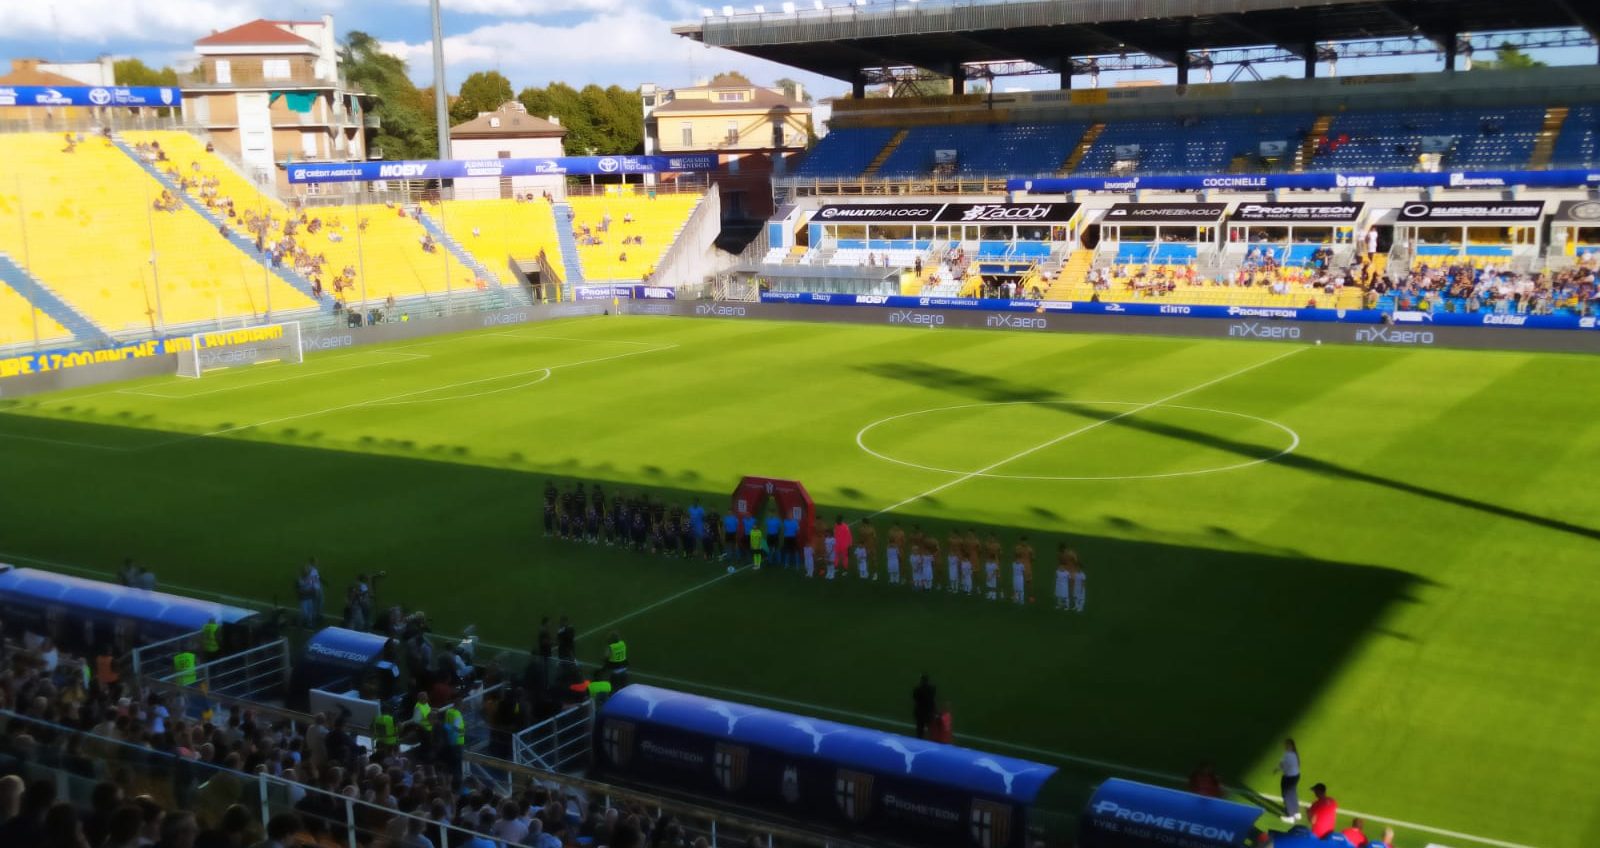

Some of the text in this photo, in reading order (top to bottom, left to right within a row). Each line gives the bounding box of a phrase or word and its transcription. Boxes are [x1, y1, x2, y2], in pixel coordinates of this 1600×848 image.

[380, 163, 428, 177] MOBY
[1203, 177, 1267, 187] COCCINELLE
[1131, 208, 1221, 216] MONTEZEMOLO
[1239, 205, 1357, 214] PROMETEON
[855, 295, 889, 304] MOBY
[1227, 305, 1297, 318] PROMETEON
[1092, 799, 1237, 843] PROMETEON
